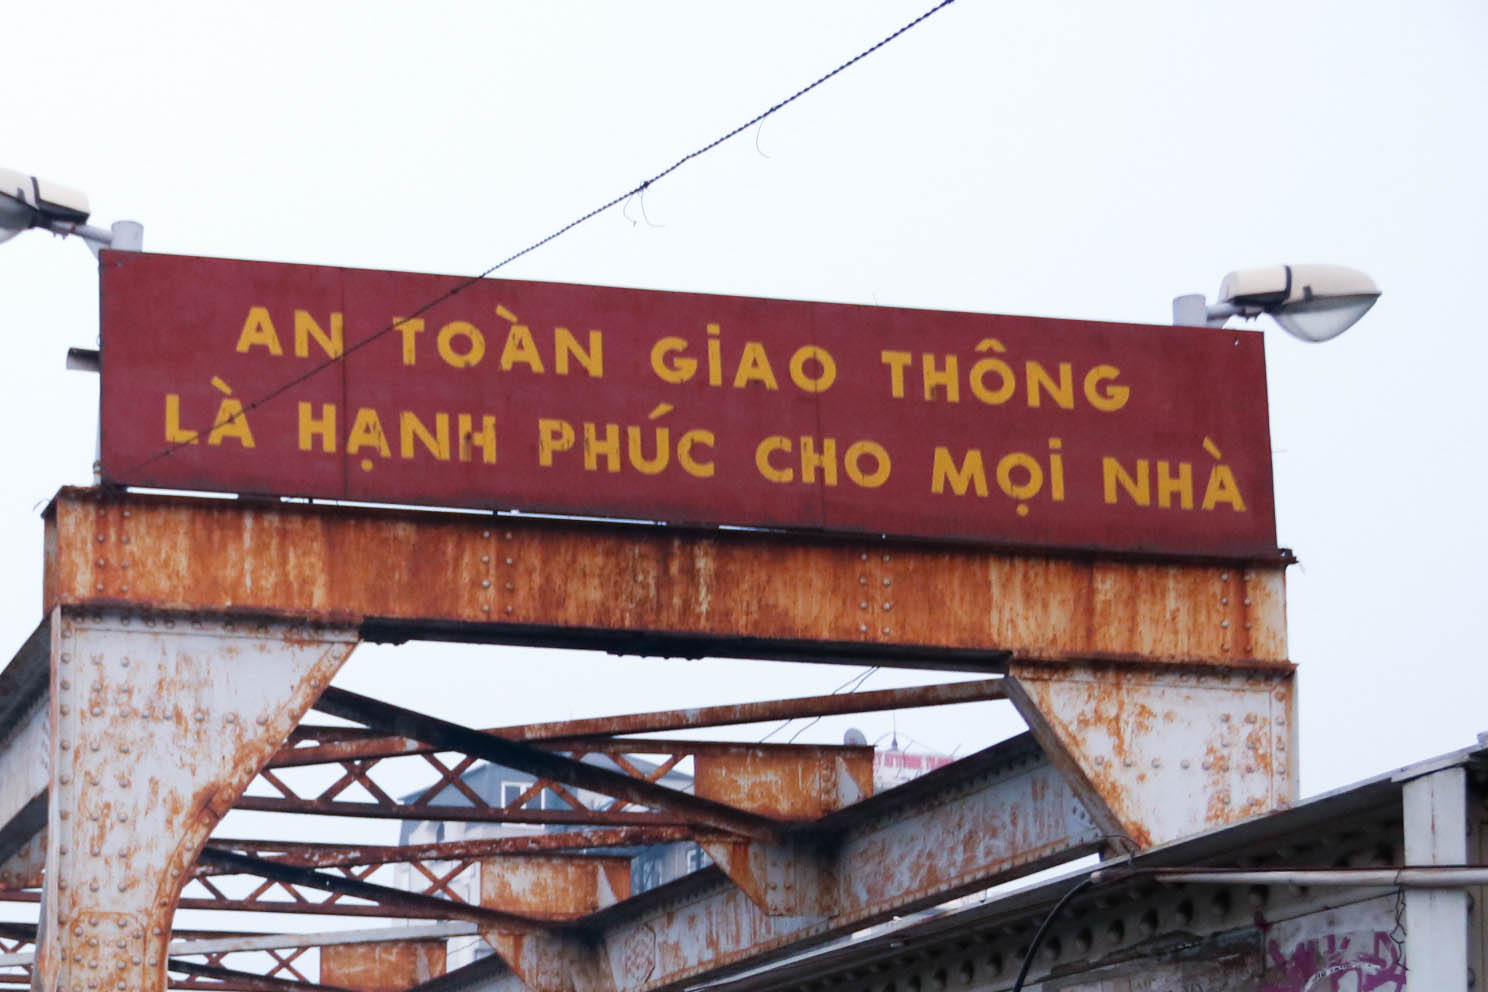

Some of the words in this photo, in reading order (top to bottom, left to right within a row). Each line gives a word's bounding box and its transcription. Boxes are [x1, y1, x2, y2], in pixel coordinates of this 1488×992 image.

[237, 306, 344, 358] AN
[393, 305, 603, 378] TOÀN
[881, 338, 1130, 412] THÔNG
[165, 376, 256, 448] LÀ
[298, 401, 497, 472] HẠNH
[539, 403, 715, 478] PHÚC
[756, 436, 891, 488] CHO
[1103, 436, 1247, 512] NHÀ
